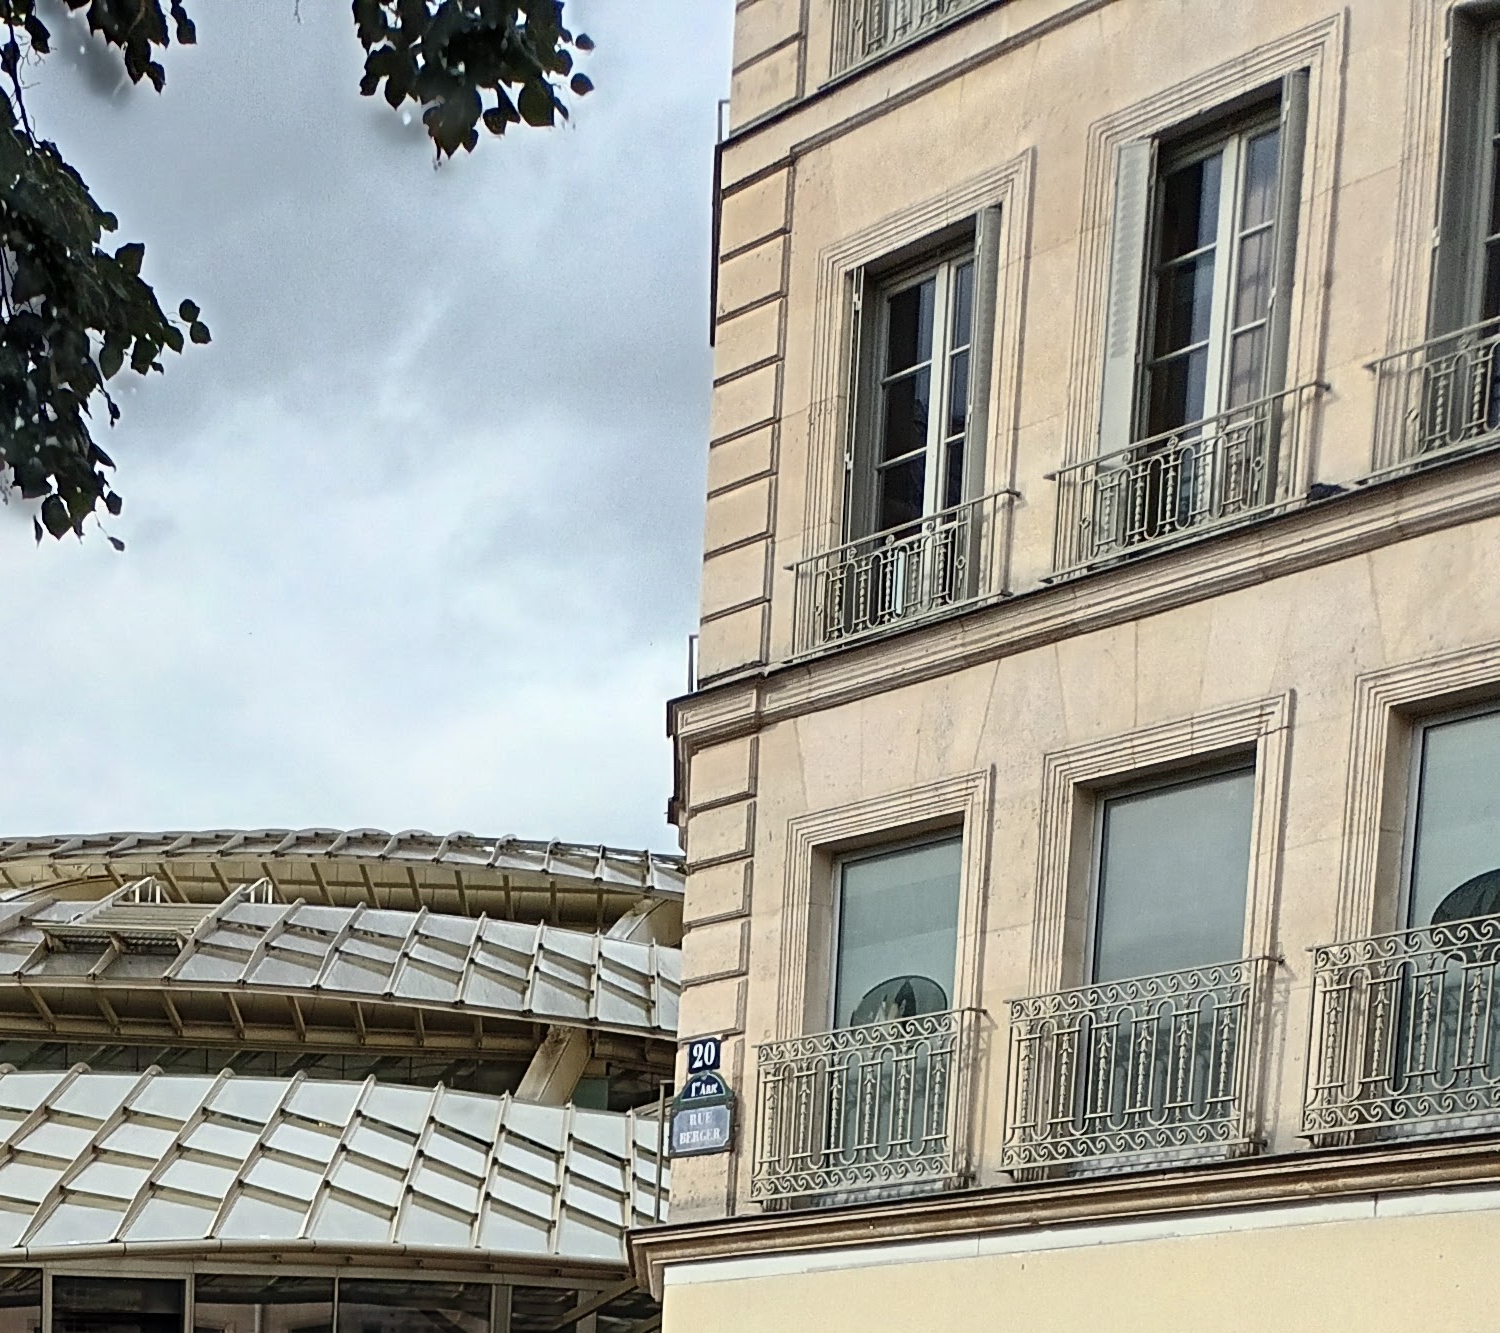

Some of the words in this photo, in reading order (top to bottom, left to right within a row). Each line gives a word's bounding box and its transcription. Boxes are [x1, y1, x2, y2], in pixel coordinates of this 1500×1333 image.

[692, 1042, 716, 1069] 20
[690, 1111, 713, 1126] RUE
[679, 1127, 721, 1145] BERGER
